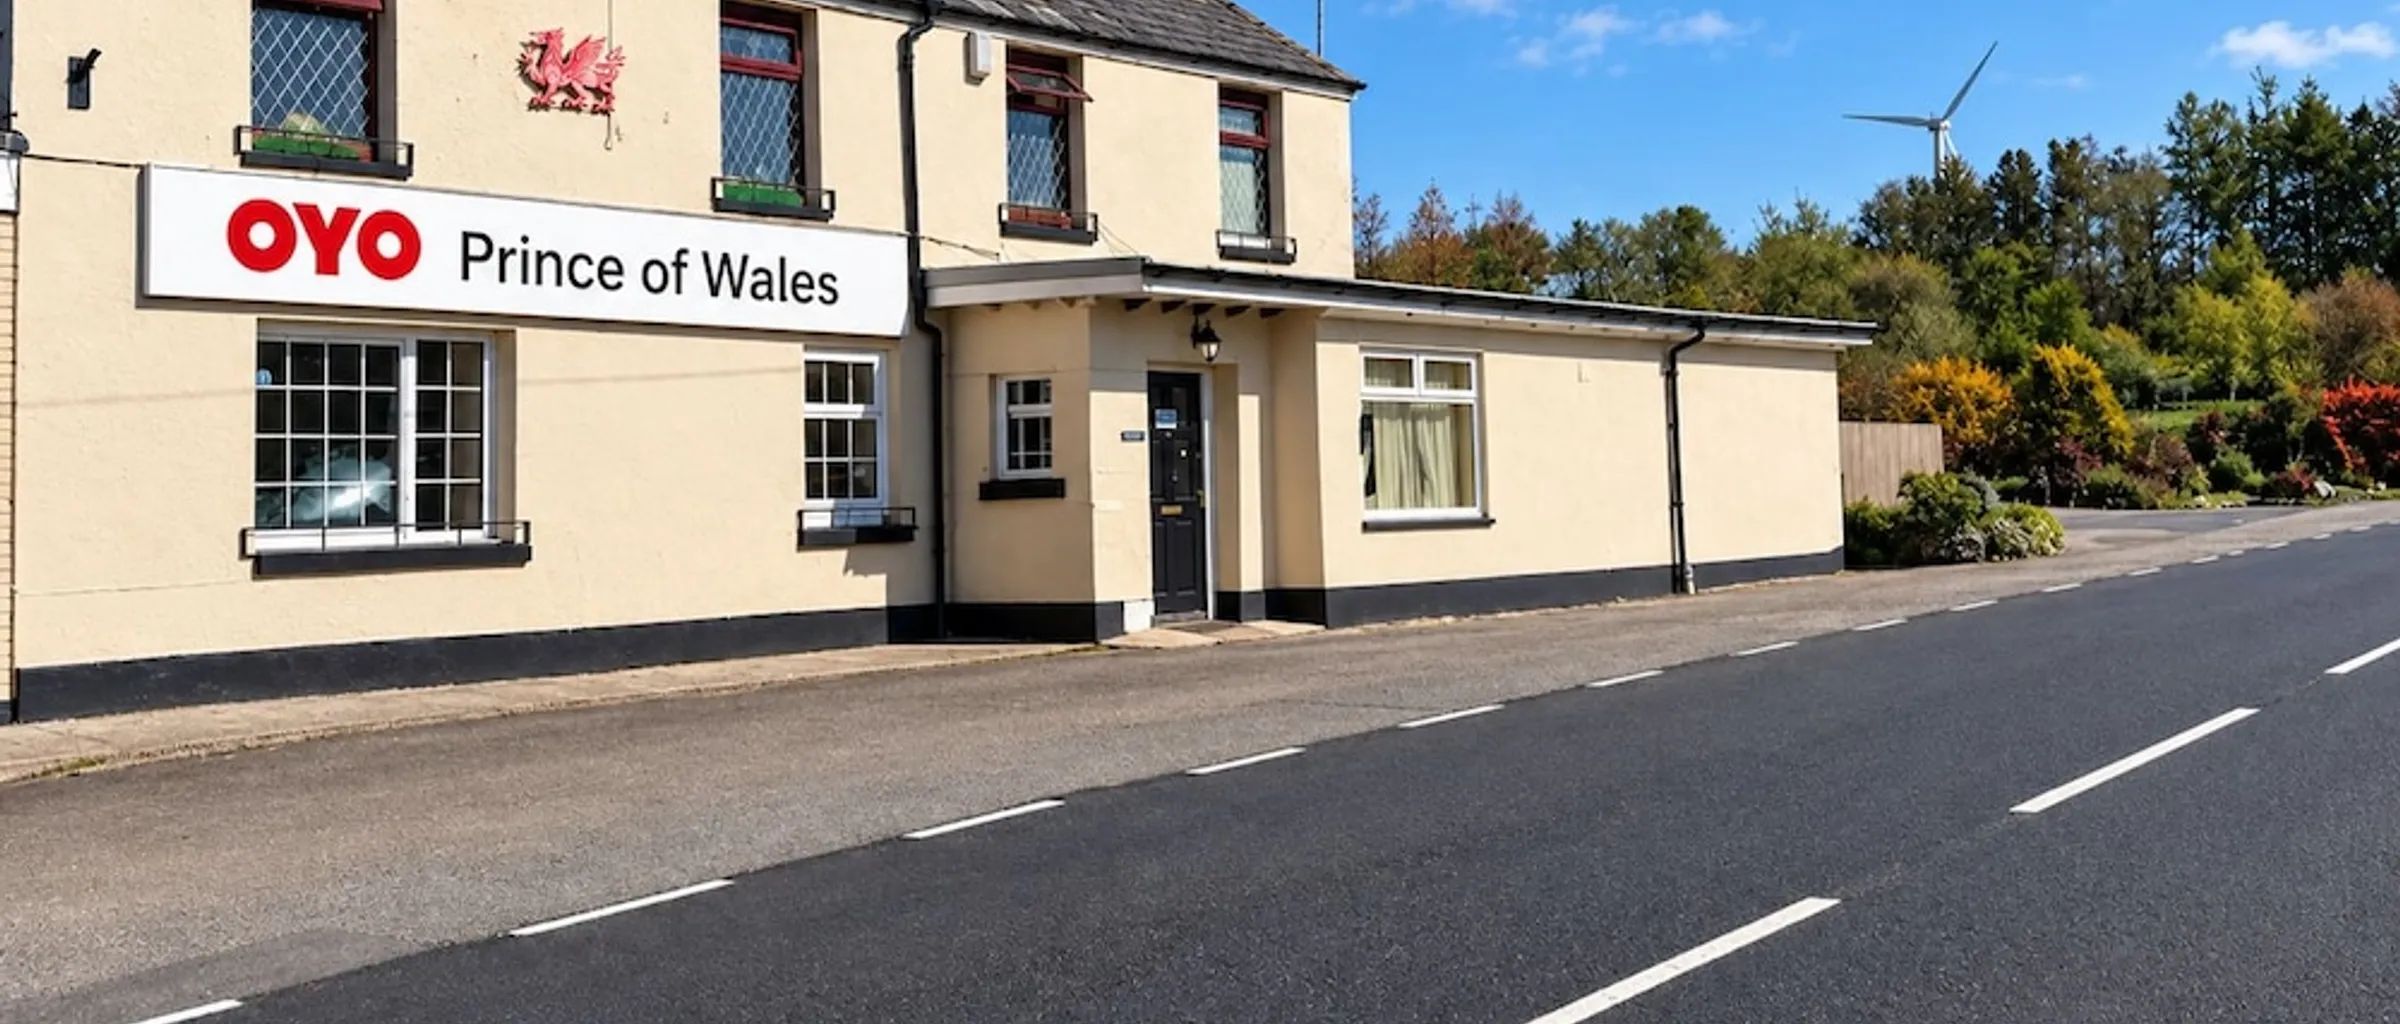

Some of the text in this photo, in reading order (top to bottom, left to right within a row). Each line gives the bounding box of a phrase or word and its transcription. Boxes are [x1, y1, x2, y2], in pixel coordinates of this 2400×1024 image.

[226, 198, 839, 306] OYO Prince of Wales
